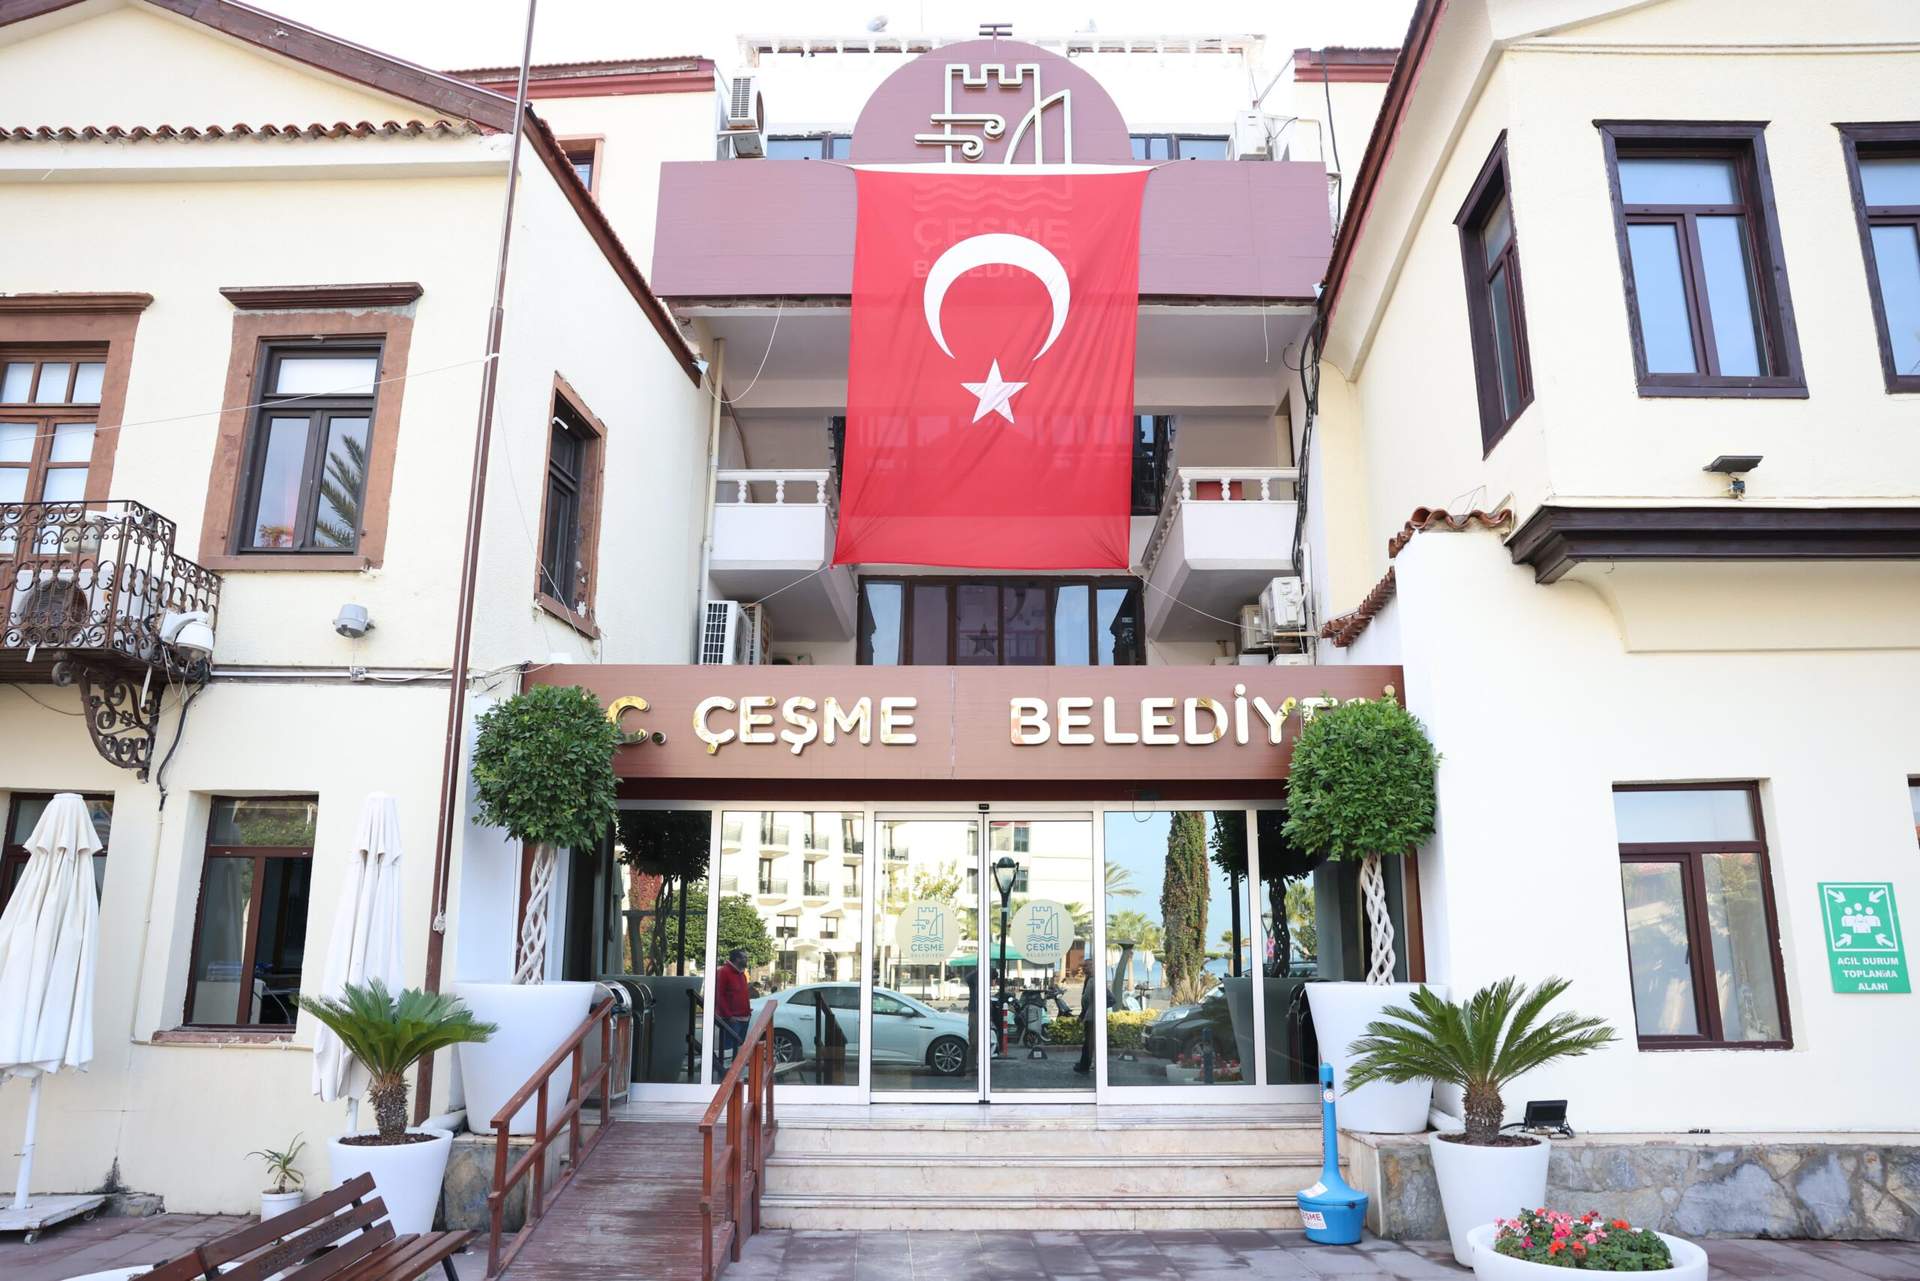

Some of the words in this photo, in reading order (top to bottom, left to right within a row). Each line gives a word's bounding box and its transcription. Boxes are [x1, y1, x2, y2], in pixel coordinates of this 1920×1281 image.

[693, 695, 918, 755] ÇEŞME
[1010, 683, 1396, 745] BELEDİY
[1863, 957, 1899, 965] DURUM
[1842, 970, 1898, 978] TOPLANMA
[1858, 983, 1888, 991] ALANI
